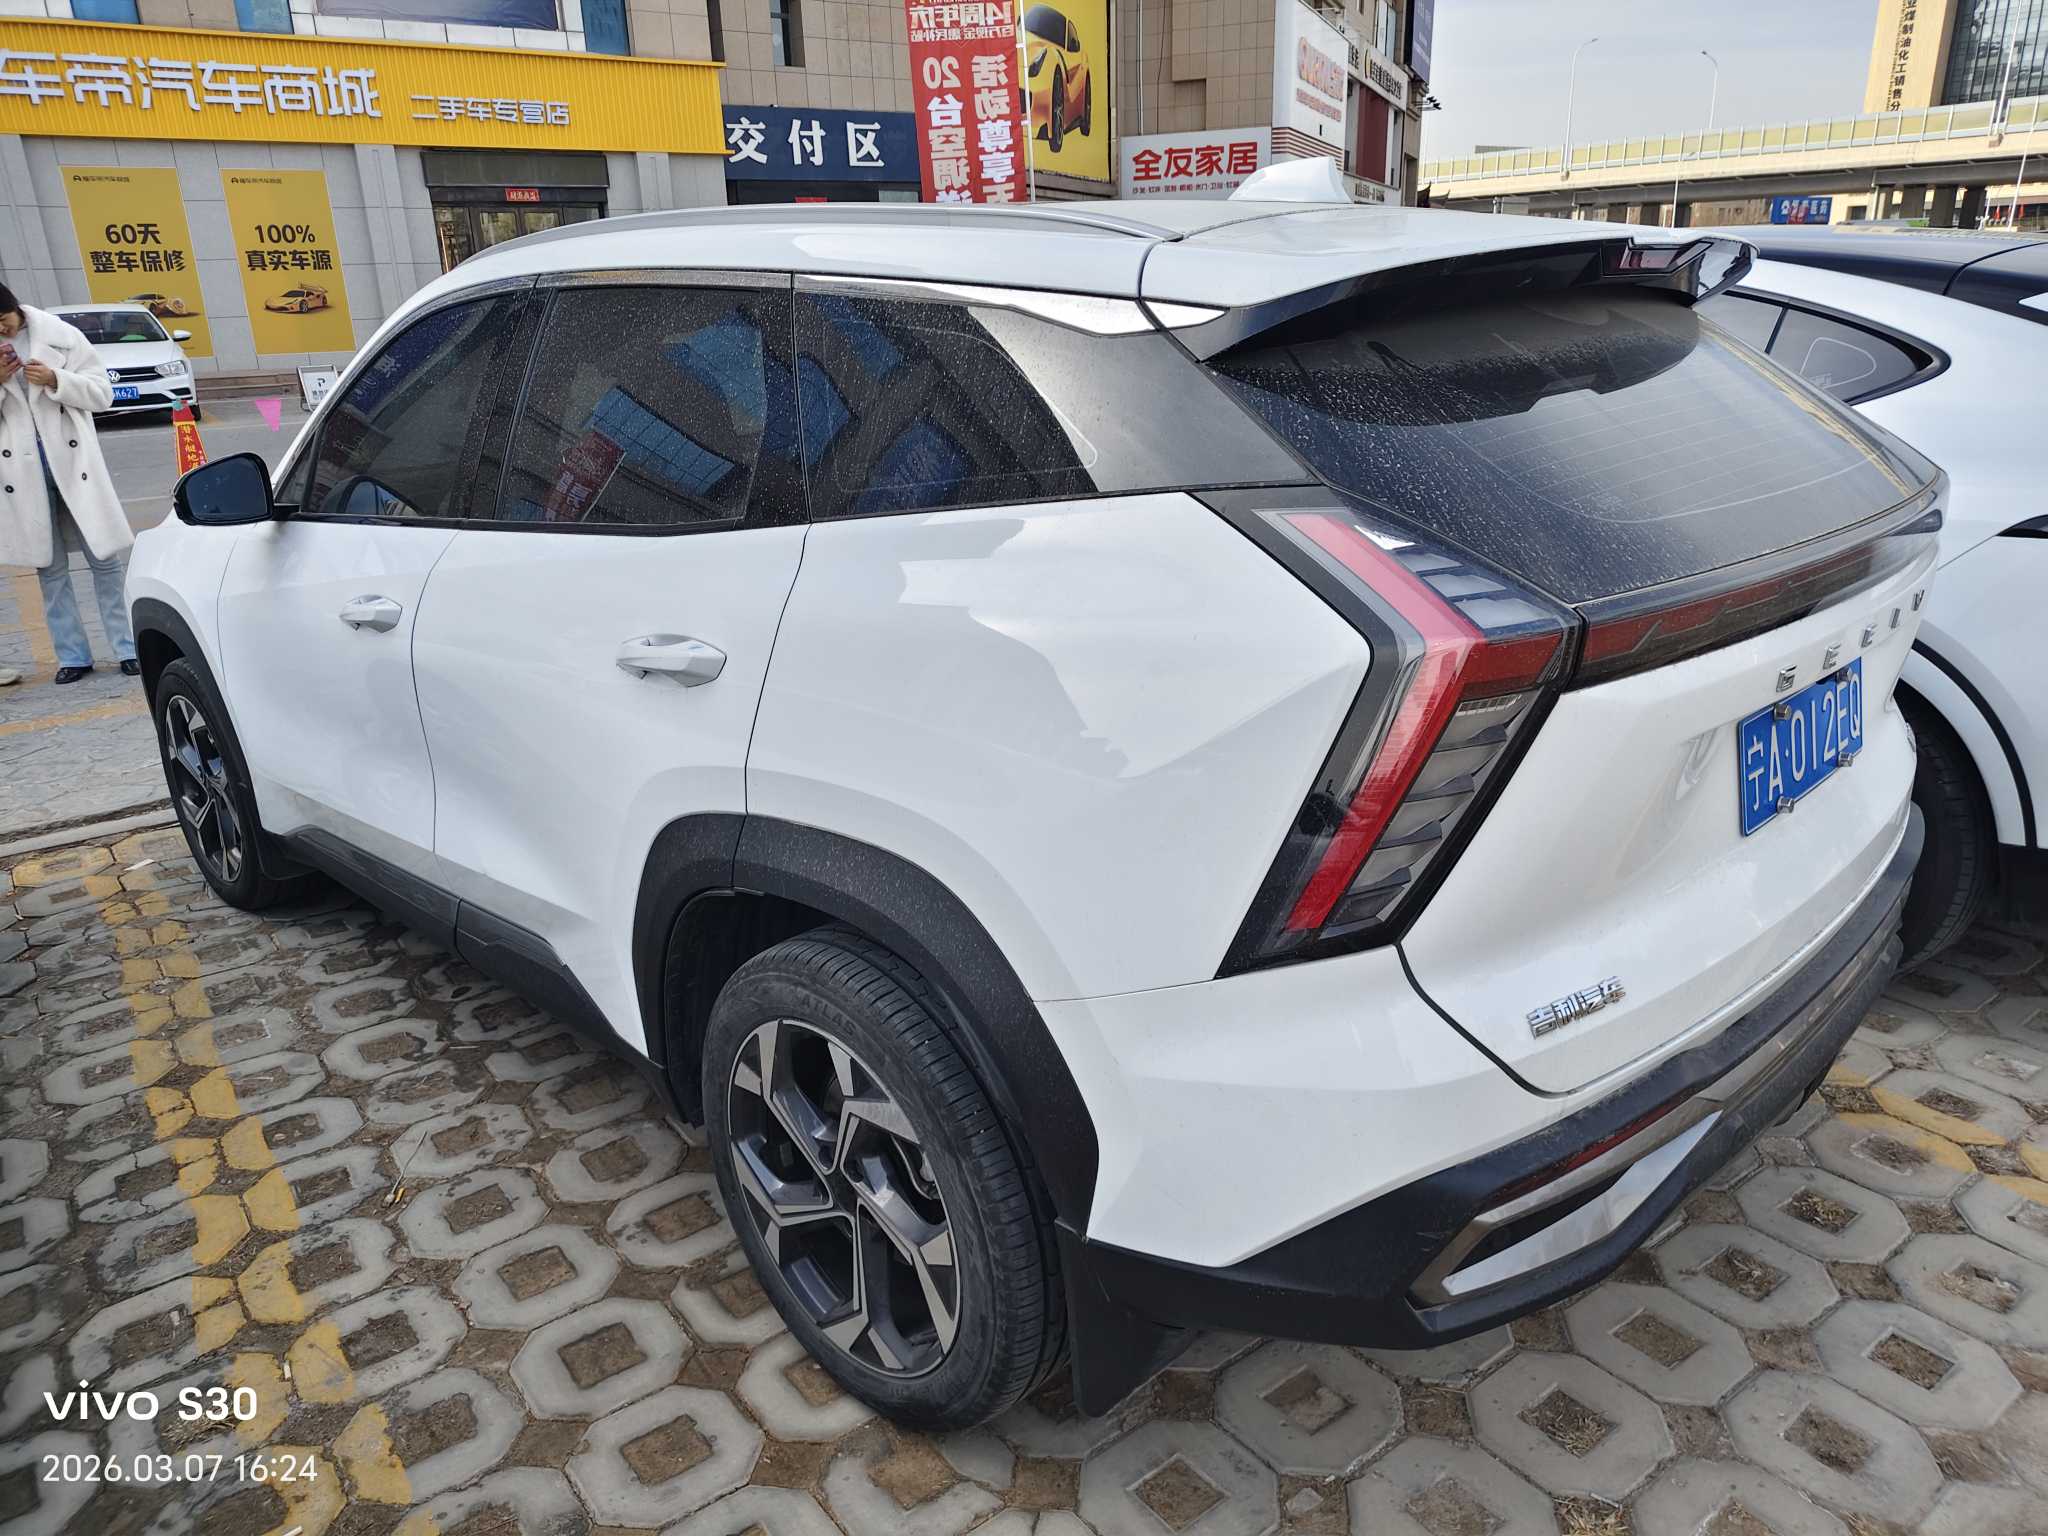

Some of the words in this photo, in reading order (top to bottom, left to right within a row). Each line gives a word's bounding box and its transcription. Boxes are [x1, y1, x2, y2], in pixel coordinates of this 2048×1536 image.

[411, 94, 570, 126] 二手车专营店
[726, 116, 885, 167] 交付区
[1132, 141, 1258, 182] 全友家居
[104, 223, 162, 245] 60天
[254, 223, 316, 244] 100%
[89, 249, 186, 273] 整车保修
[245, 249, 333, 271] 真实车源
